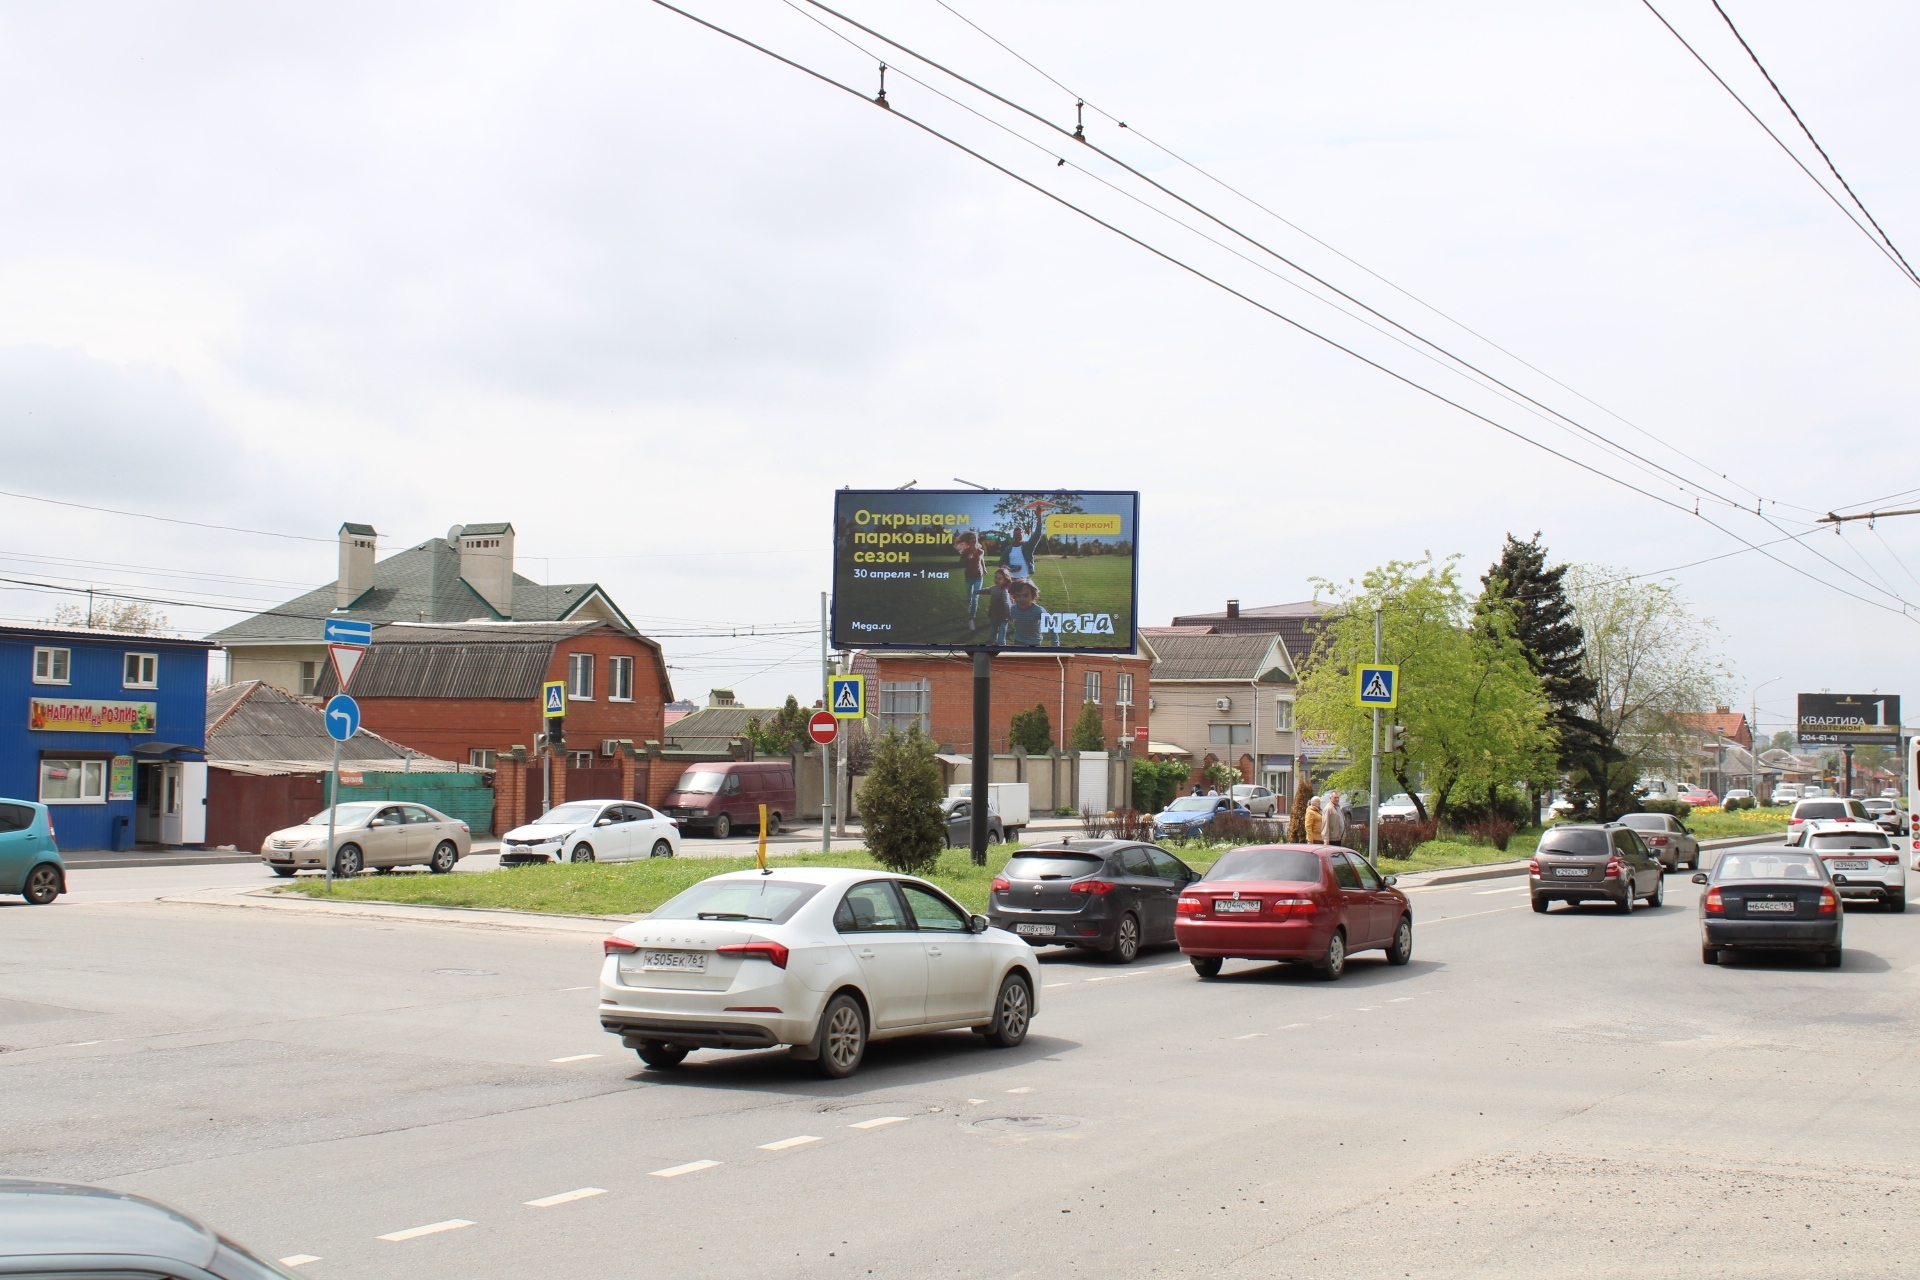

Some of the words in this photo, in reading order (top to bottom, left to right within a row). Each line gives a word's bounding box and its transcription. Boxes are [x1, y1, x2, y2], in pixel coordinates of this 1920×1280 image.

[854, 509, 970, 529] Открываем
[1053, 520, 1061, 529] С
[1063, 520, 1113, 530] ветерком!
[854, 528, 953, 548] парковый
[853, 551, 910, 563] сезон
[853, 568, 868, 579] 30
[869, 571, 911, 580] апреля
[919, 569, 925, 579] 1
[927, 571, 950, 579] мая
[851, 621, 892, 632] Mega.ru
[46, 704, 92, 722] НАПИТКИ
[91, 715, 102, 727] НА
[101, 706, 138, 723] РОЗЛИВ
[1873, 699, 1889, 727] 1
[1801, 716, 1866, 726] КВАРТИРА
[1749, 902, 1779, 910] М644СС
[647, 953, 686, 966] К505ЕК
[687, 954, 705, 965] 761
